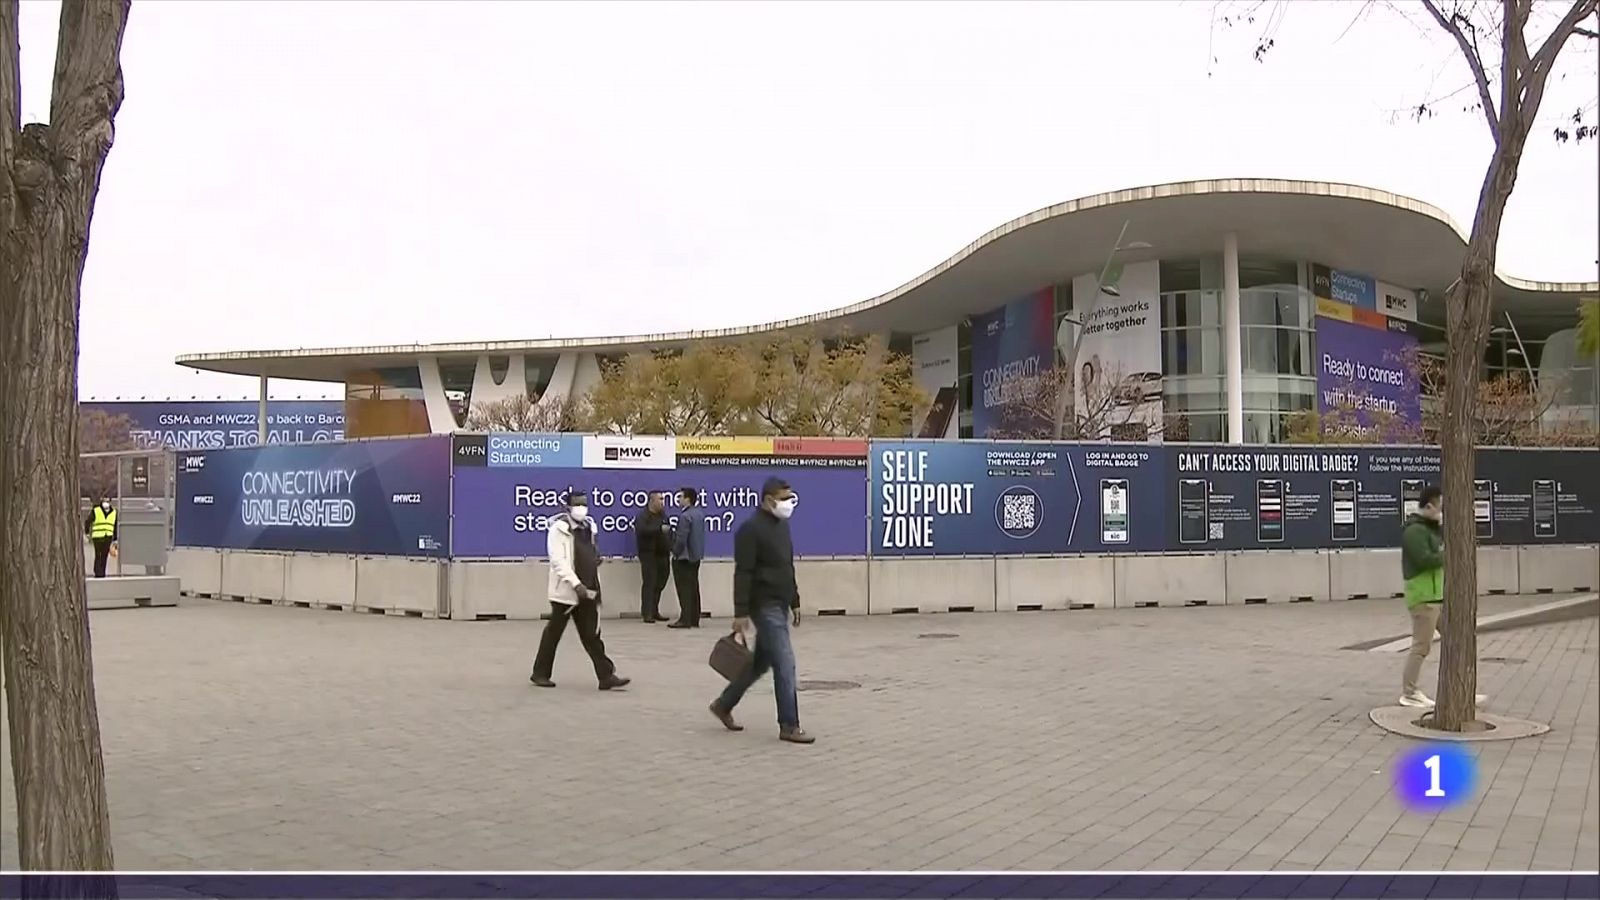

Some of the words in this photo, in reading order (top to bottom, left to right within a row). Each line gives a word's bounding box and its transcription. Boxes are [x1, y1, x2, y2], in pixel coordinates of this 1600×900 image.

[1120, 301, 1149, 314] works
[1106, 316, 1147, 332] together
[983, 356, 1040, 388] CONNECTIVITY
[1323, 353, 1355, 382] Ready
[1356, 361, 1367, 380] to
[1368, 367, 1404, 386] connect
[159, 414, 191, 425] GSMA
[193, 414, 213, 425] and
[215, 414, 256, 425] MWC22
[276, 413, 301, 424] back
[304, 414, 316, 424] to
[129, 430, 225, 449] THANKS
[229, 430, 260, 447] TO
[490, 437, 560, 452] Connecting
[681, 442, 721, 451] Welcome
[458, 446, 485, 456] 4YFN
[490, 451, 541, 465] Startups
[619, 447, 651, 457] MWC
[186, 456, 204, 467] MWC
[882, 451, 928, 482] SELF
[1178, 453, 1209, 471] CAN'T
[1212, 454, 1251, 471] ACCESS
[1254, 454, 1280, 471] YOUR
[1282, 454, 1320, 471] DIGITAL
[1322, 454, 1359, 471] BADGE?
[1369, 455, 1375, 463] If
[1376, 457, 1389, 465] you
[1415, 455, 1422, 463] of
[1423, 455, 1440, 463] these
[1369, 463, 1389, 471] follow
[1403, 463, 1440, 471] instructions
[242, 470, 356, 494] CONNECTIVITY
[1209, 482, 1213, 492] 1
[1285, 482, 1291, 492] 2
[1357, 482, 1362, 492] 3
[392, 494, 421, 502] #MWC22
[592, 487, 614, 506] to
[714, 487, 758, 507] with
[882, 484, 974, 515] SUPPORT
[242, 499, 355, 526] UNLEASHED
[882, 516, 933, 547] ZONE
